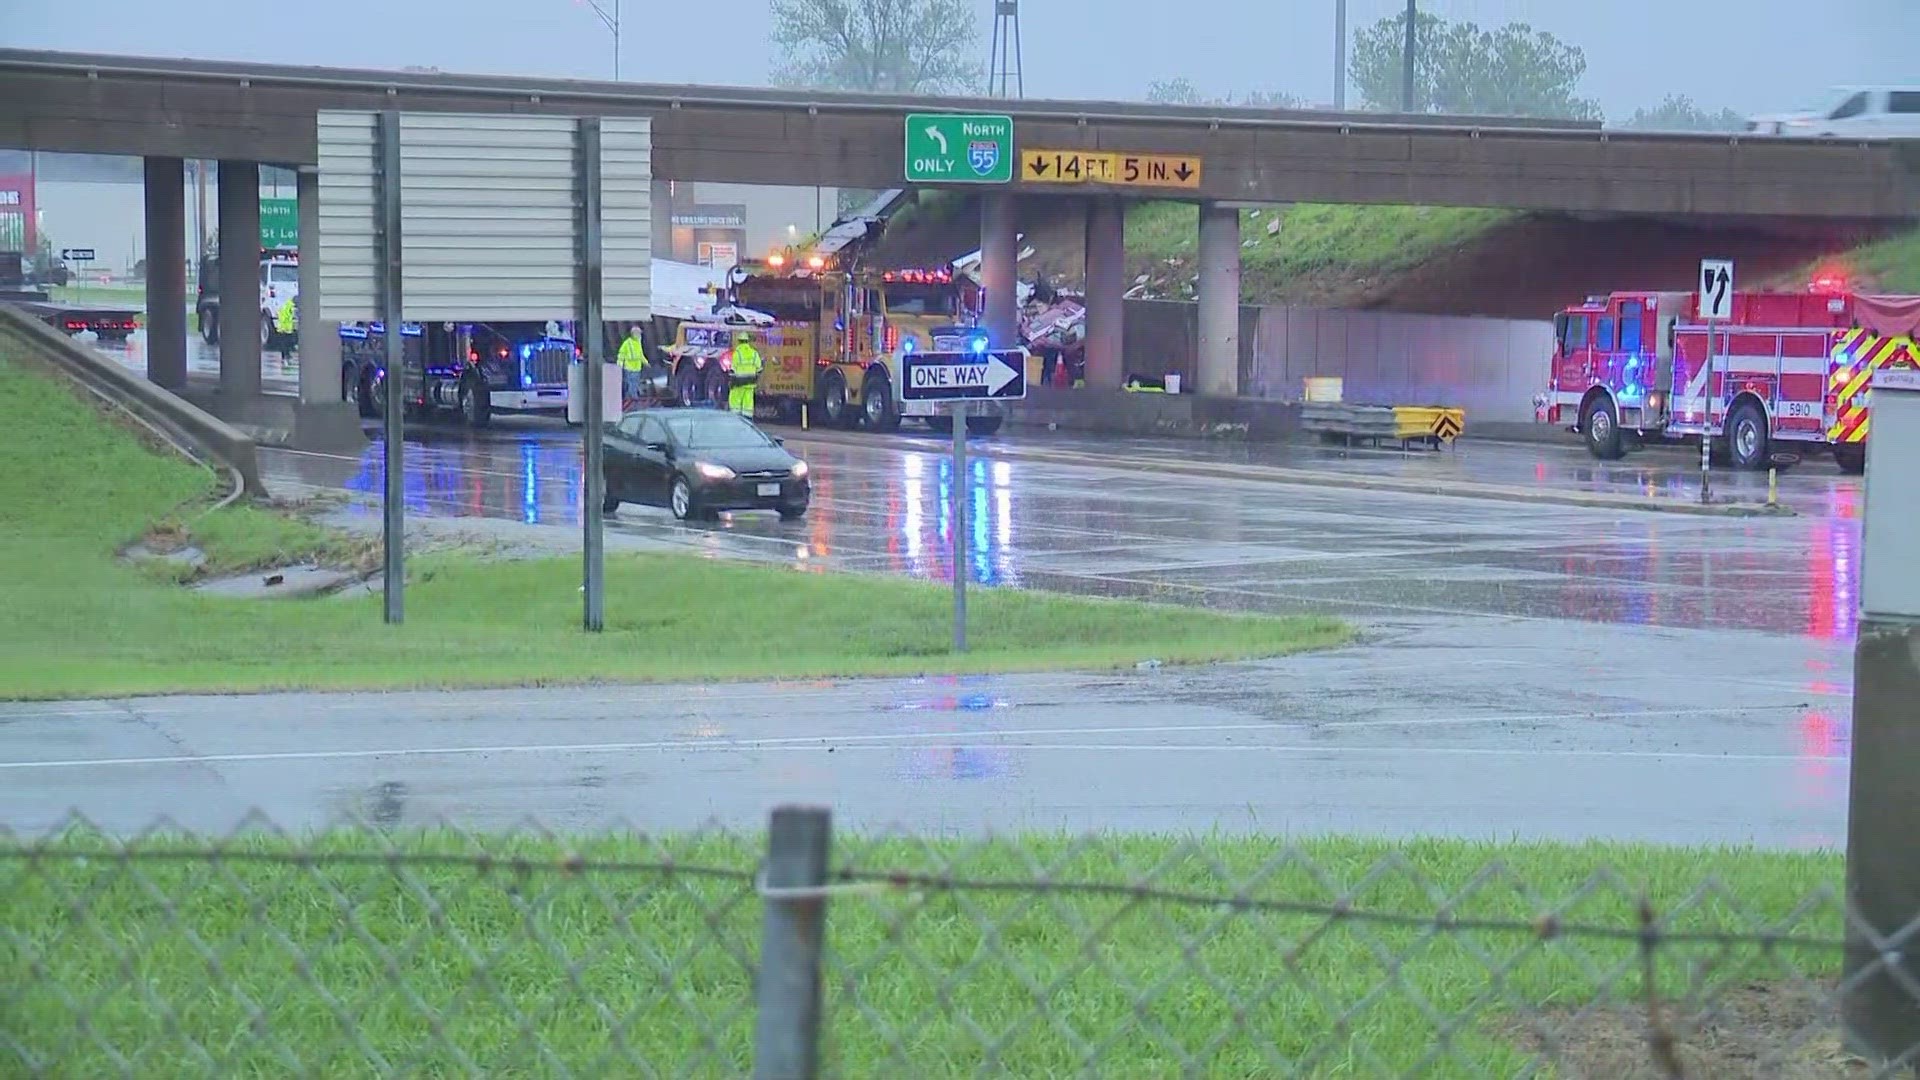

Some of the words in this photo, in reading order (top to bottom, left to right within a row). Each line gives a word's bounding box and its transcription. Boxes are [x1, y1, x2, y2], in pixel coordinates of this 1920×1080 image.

[963, 122, 1005, 137] NORTH
[914, 158, 955, 172] ONLY
[972, 151, 994, 168] 55
[1055, 155, 1081, 179] 14
[1124, 158, 1139, 182] 5
[1147, 160, 1170, 181] IN.
[260, 204, 290, 215] NORTH
[262, 228, 275, 239] St
[916, 367, 947, 386] ONE
[954, 367, 988, 384] WAY
[1789, 403, 1811, 416] 5910
